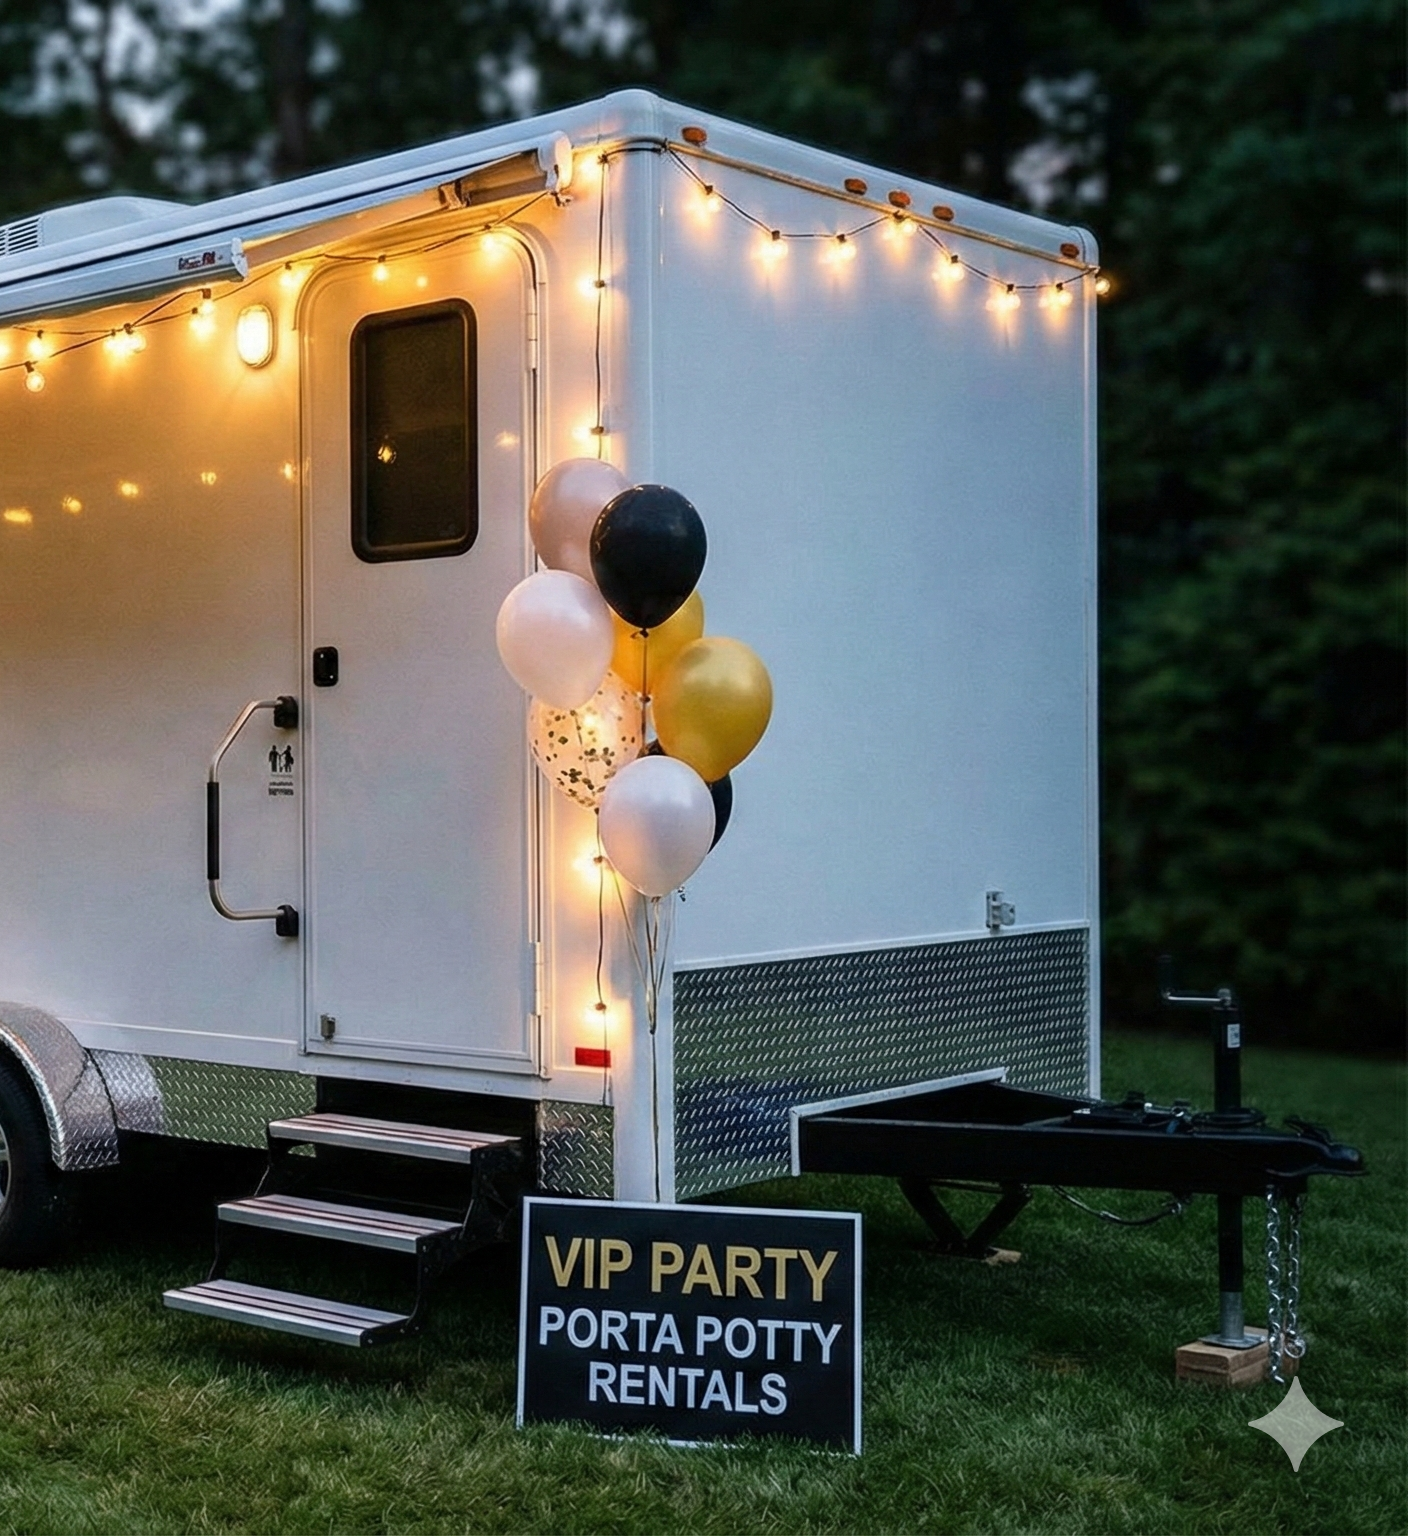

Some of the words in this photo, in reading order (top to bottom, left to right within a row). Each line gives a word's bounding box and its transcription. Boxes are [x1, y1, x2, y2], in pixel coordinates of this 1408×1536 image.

[545, 1235, 633, 1290] VIP
[651, 1241, 838, 1302] PARTY
[539, 1305, 685, 1355] PORTA
[696, 1315, 843, 1365] POTTY
[588, 1360, 788, 1416] RENTALS
